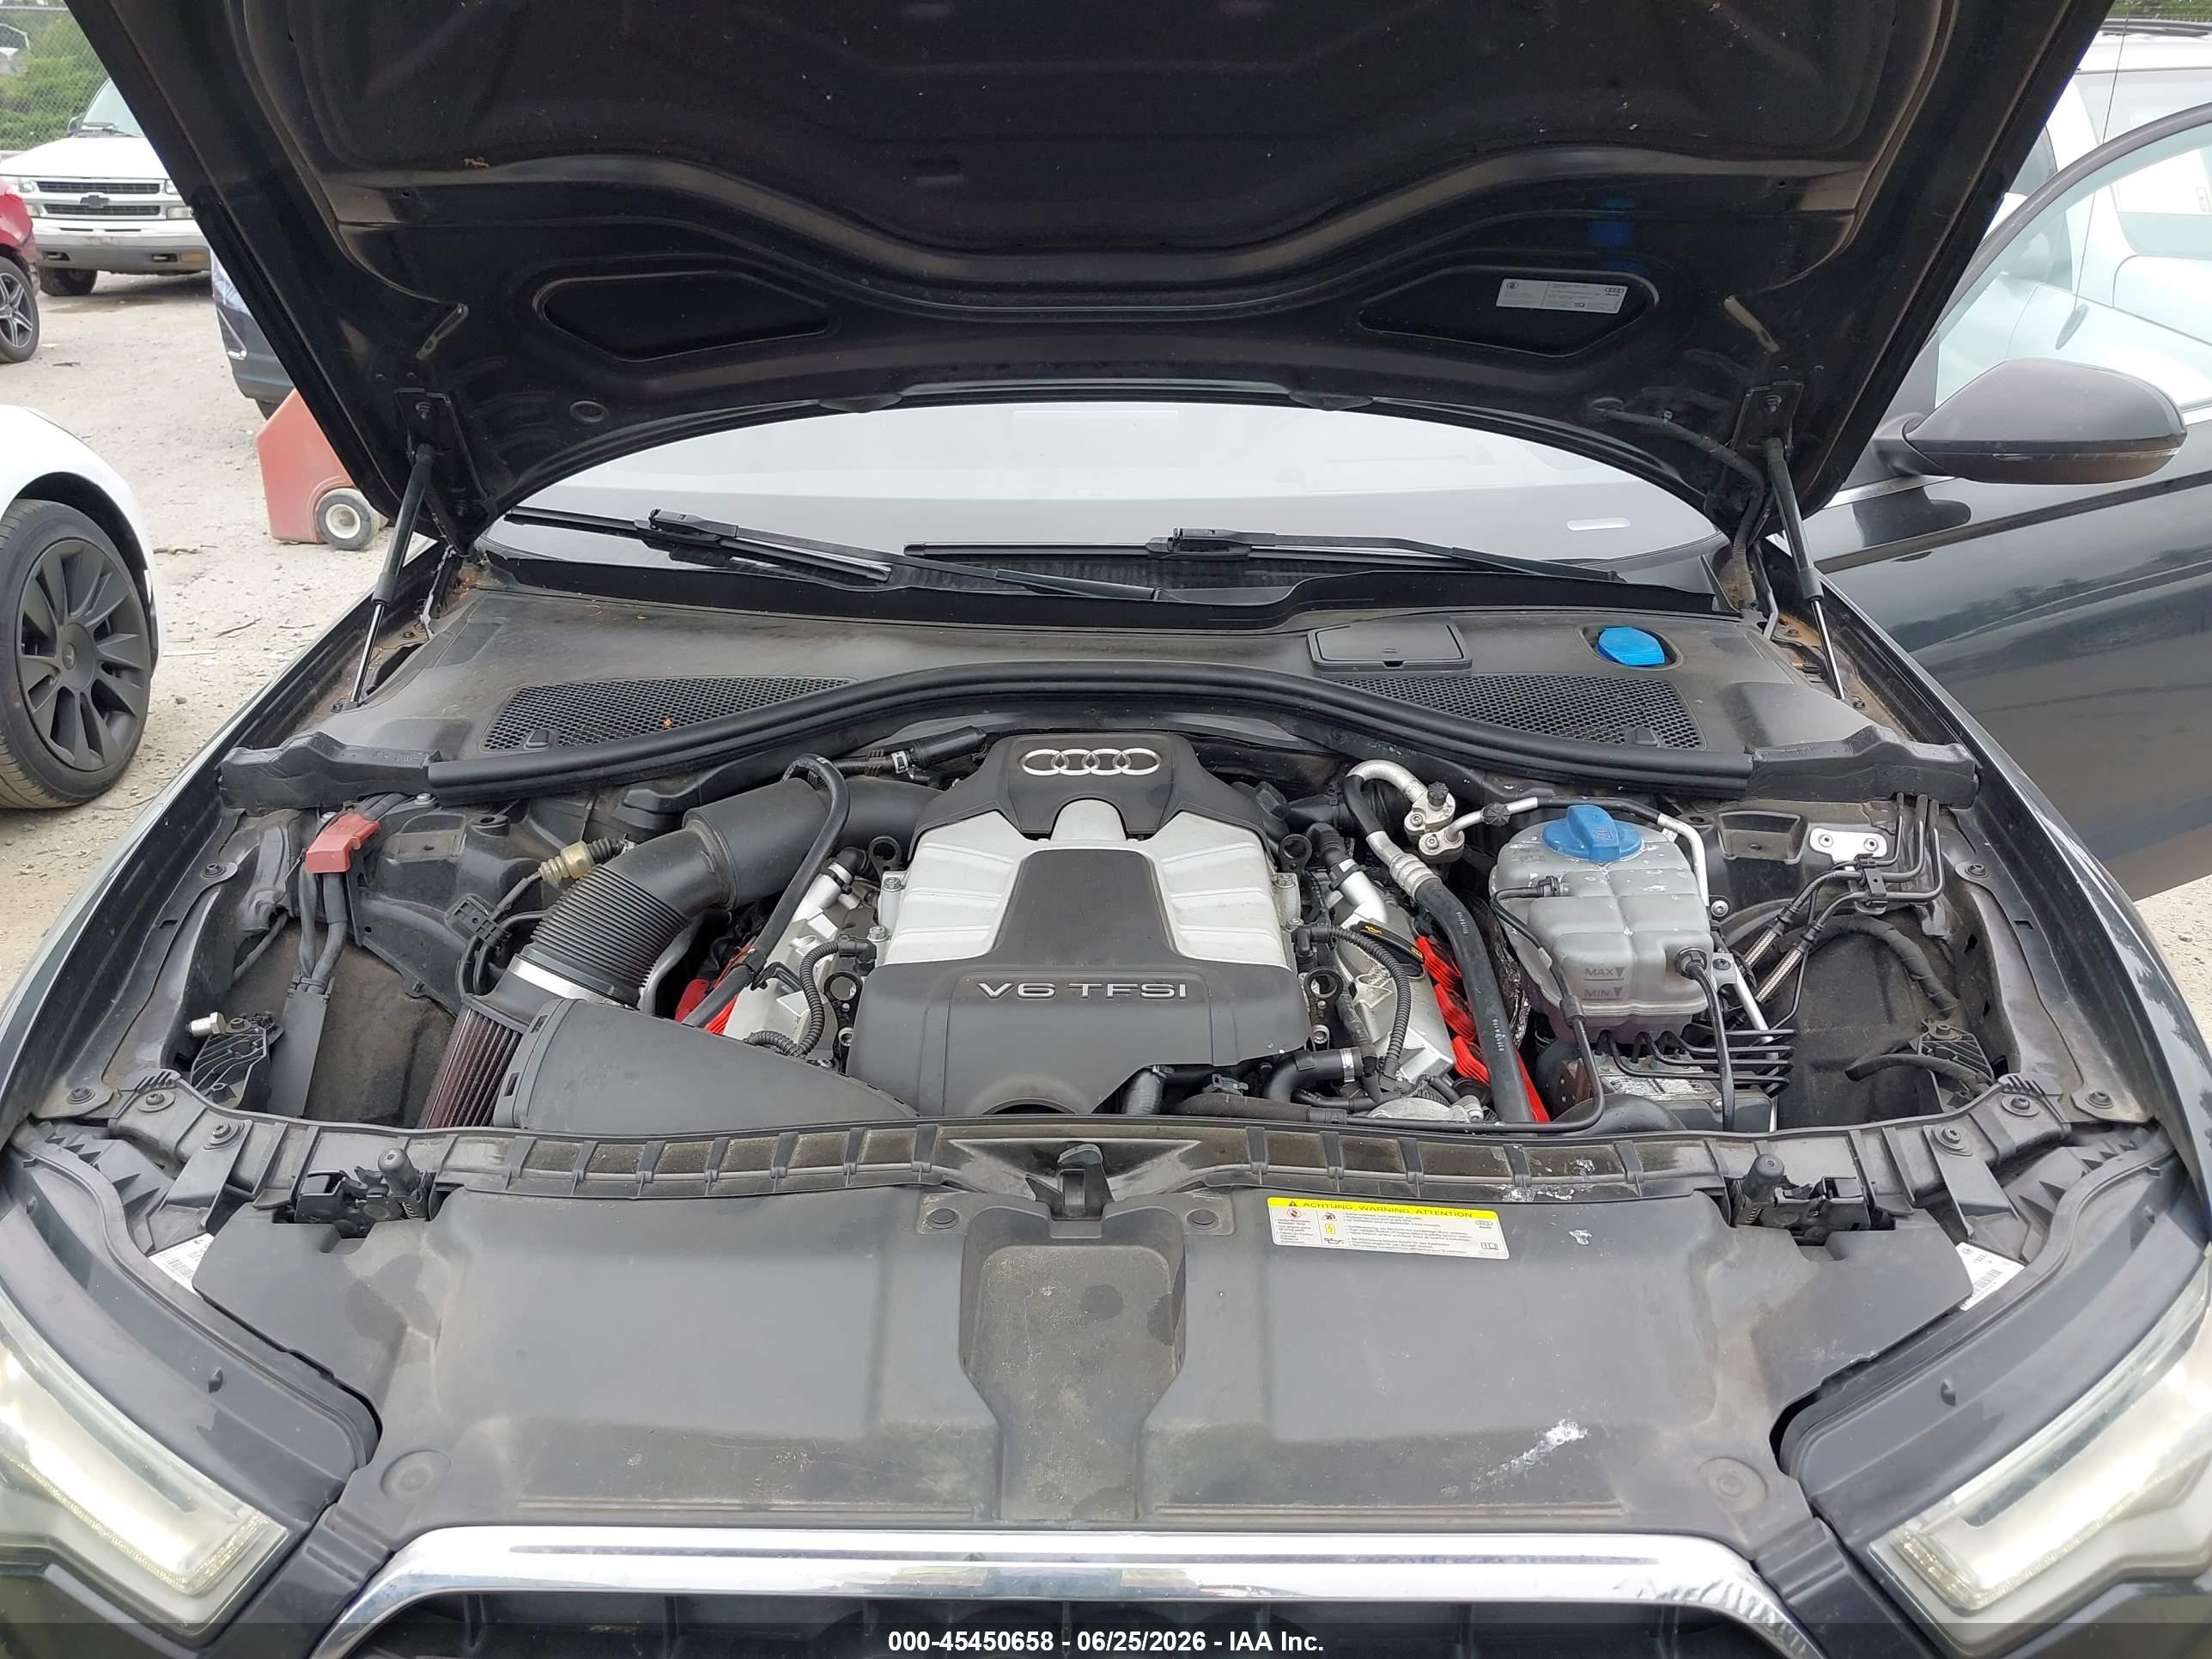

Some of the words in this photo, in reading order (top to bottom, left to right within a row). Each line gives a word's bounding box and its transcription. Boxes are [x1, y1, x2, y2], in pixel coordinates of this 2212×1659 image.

[1585, 968, 1614, 976] MAX
[977, 982, 1057, 1000] V6
[1068, 982, 1188, 1000] TFSI
[1583, 988, 1610, 997] MIN
[1303, 1201, 1353, 1210] ACHTUNG
[1358, 1206, 1410, 1214] WARNING
[1416, 1209, 1474, 1218] ATTENTION
